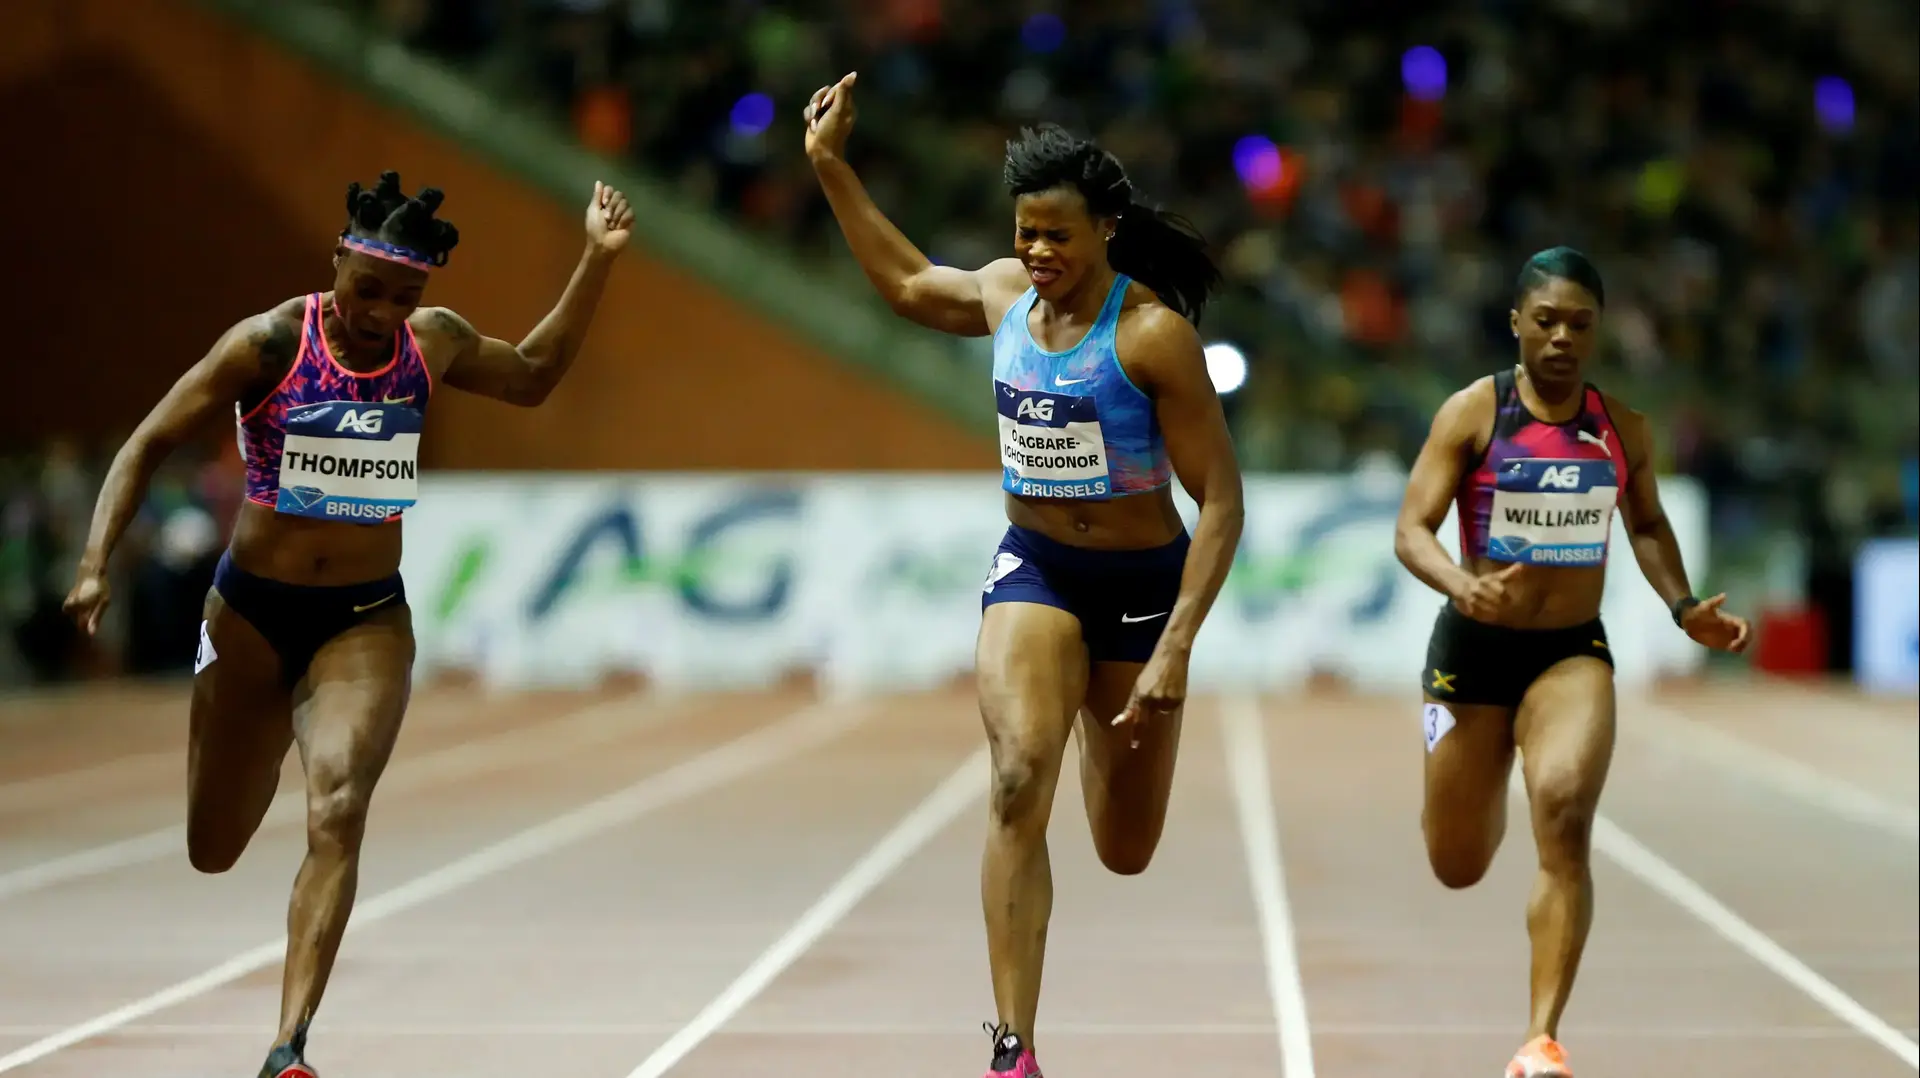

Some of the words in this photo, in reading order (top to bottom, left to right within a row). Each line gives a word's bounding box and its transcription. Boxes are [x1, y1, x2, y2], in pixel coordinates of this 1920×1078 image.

[1017, 397, 1055, 421] AG
[335, 409, 384, 433] AG
[1012, 429, 1080, 450] OAGBARE-
[286, 451, 414, 480] THOMPSON
[1538, 465, 1580, 489] AG
[1022, 481, 1106, 498] BRUSSELS
[326, 501, 402, 519] BRUSSE
[1505, 507, 1601, 527] WILLIAMS
[1531, 547, 1602, 562] BRUSSELS
[1427, 708, 1439, 741] 3
